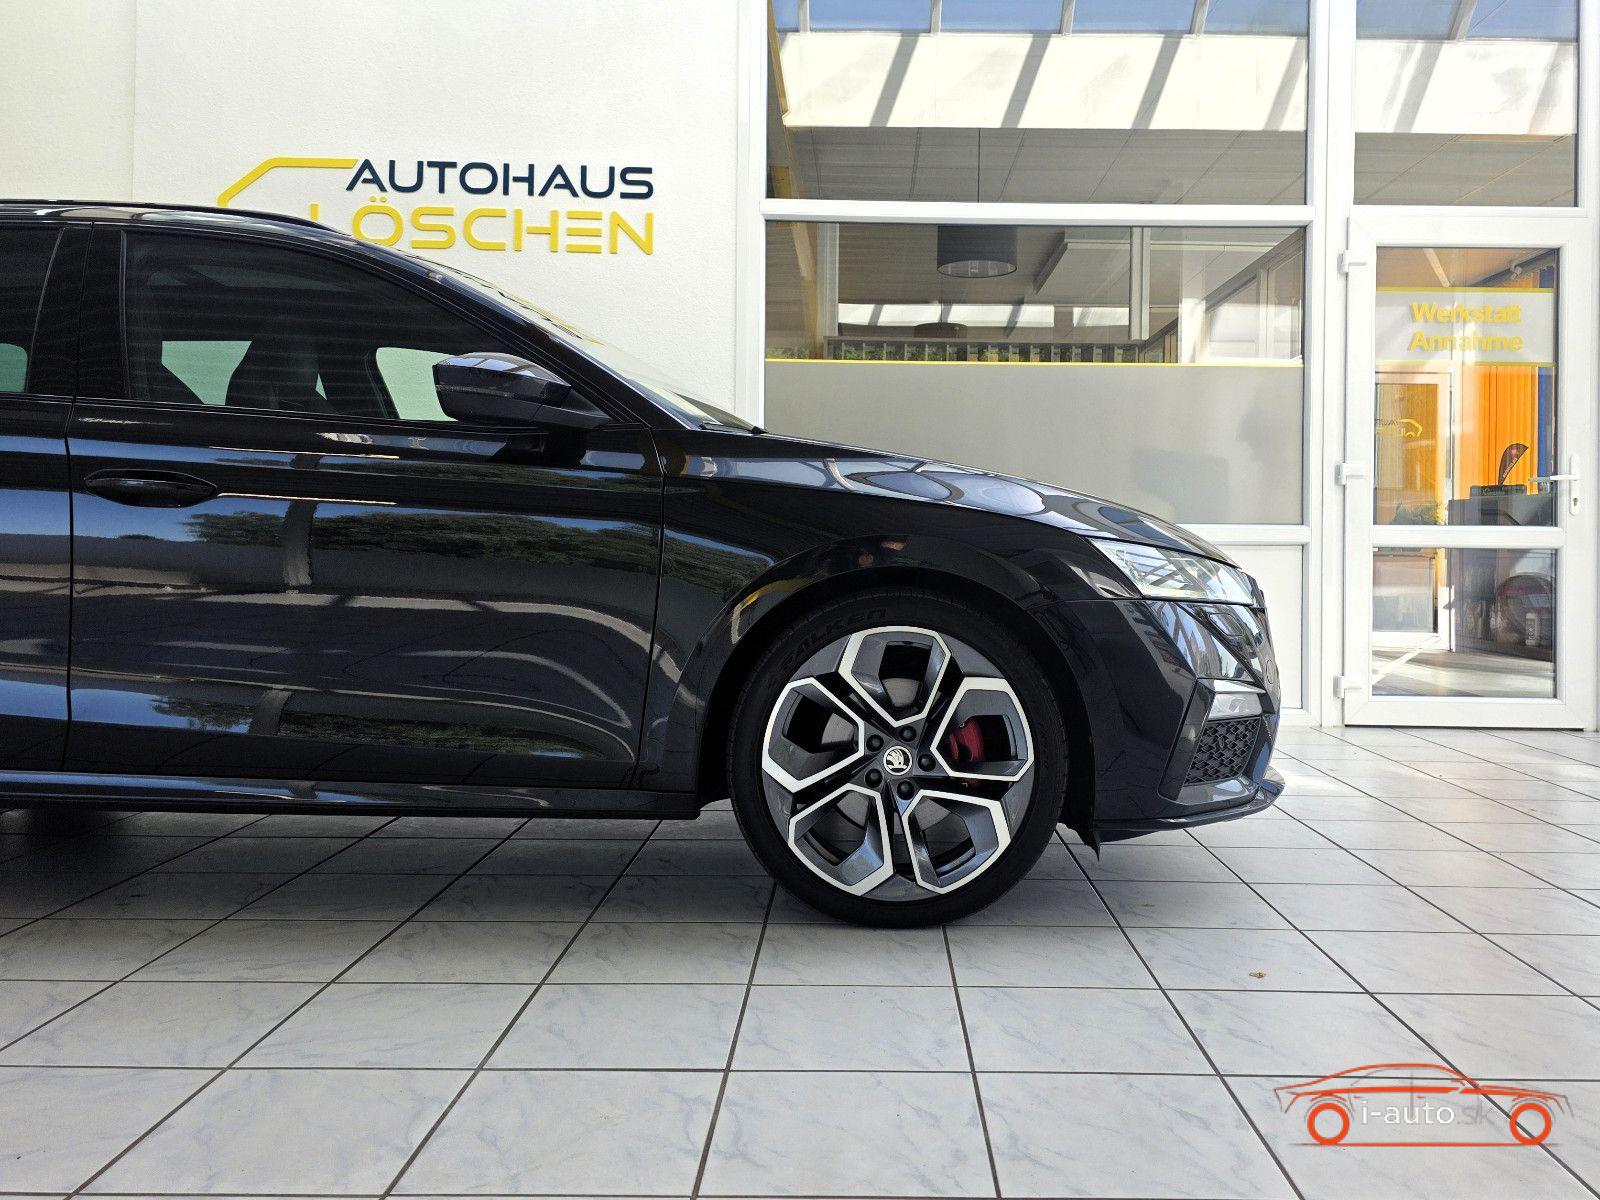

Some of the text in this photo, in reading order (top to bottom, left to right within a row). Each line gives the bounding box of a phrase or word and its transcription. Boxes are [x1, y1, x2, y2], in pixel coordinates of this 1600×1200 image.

[346, 158, 654, 199] AUTOHAUS
[1411, 302, 1521, 323] Werkstatt
[1409, 331, 1523, 351] Annahme
